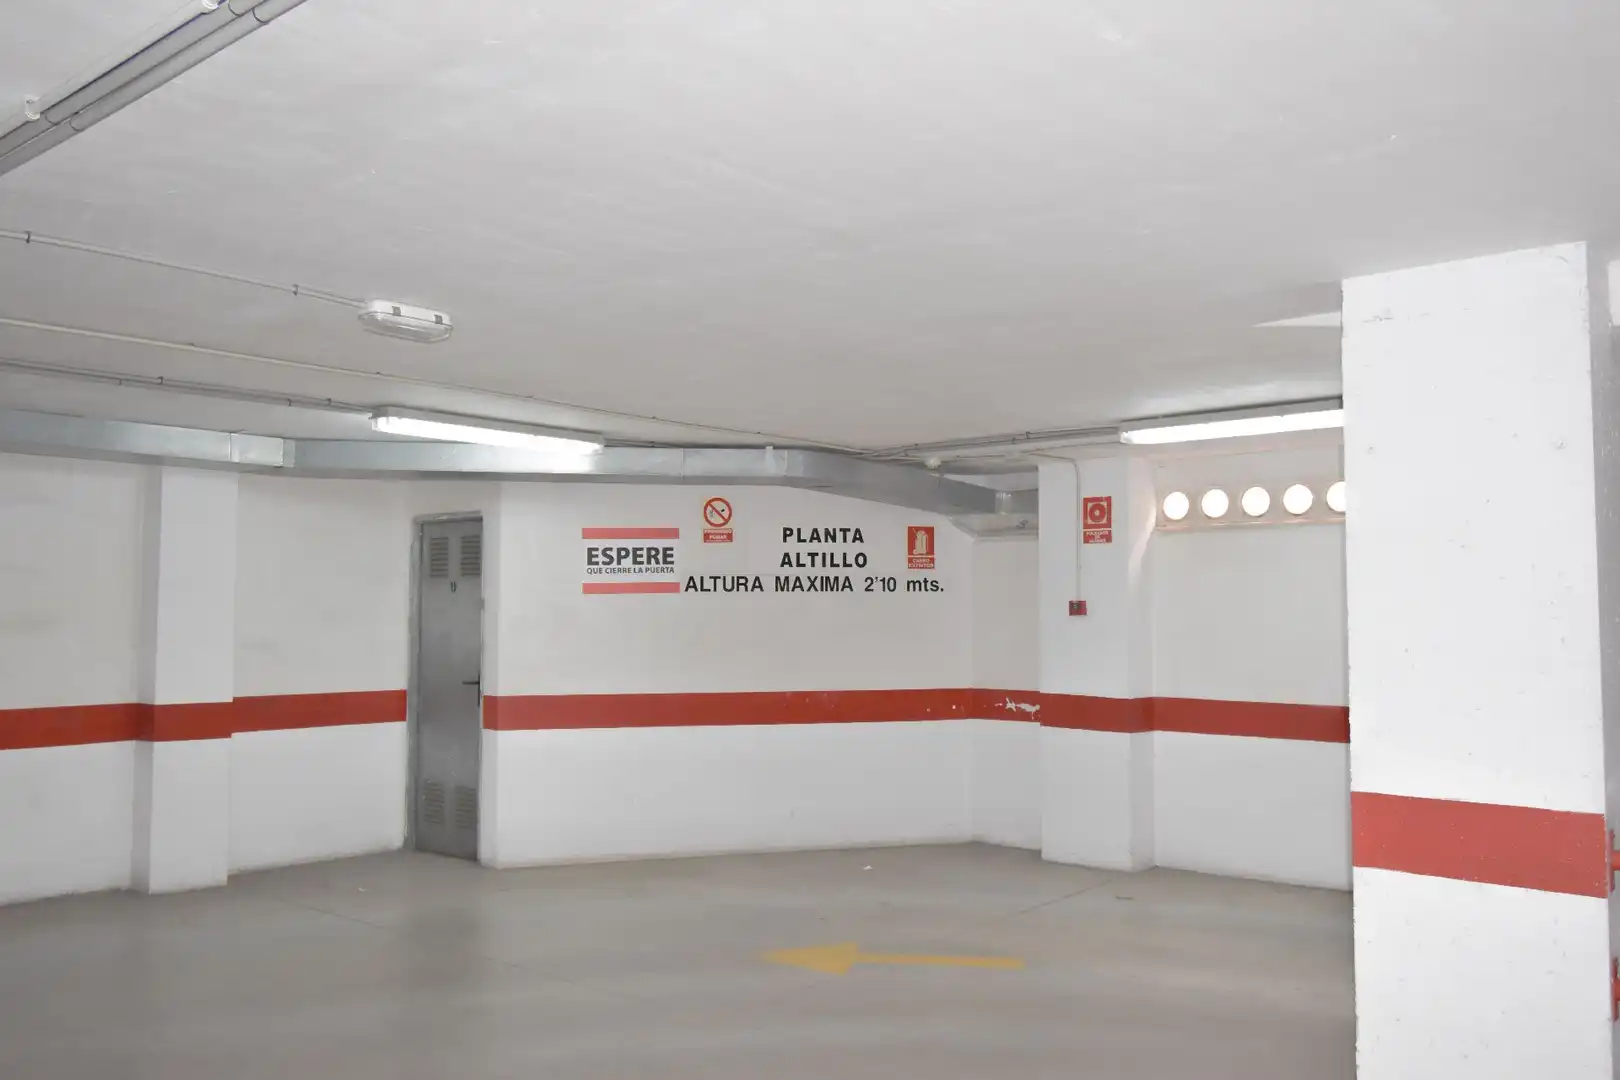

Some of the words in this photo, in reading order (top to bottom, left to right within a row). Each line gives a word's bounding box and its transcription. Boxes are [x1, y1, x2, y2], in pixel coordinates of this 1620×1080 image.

[782, 527, 864, 543] PLANTA
[587, 547, 674, 566] ESPERE
[780, 552, 868, 568] ALTILLO
[586, 567, 602, 575] QUE
[604, 567, 632, 575] CIERRE
[645, 566, 675, 574] PUERTA
[684, 576, 764, 592] ALTURA
[774, 576, 853, 592] MAXIMA
[906, 578, 944, 592] mts.
